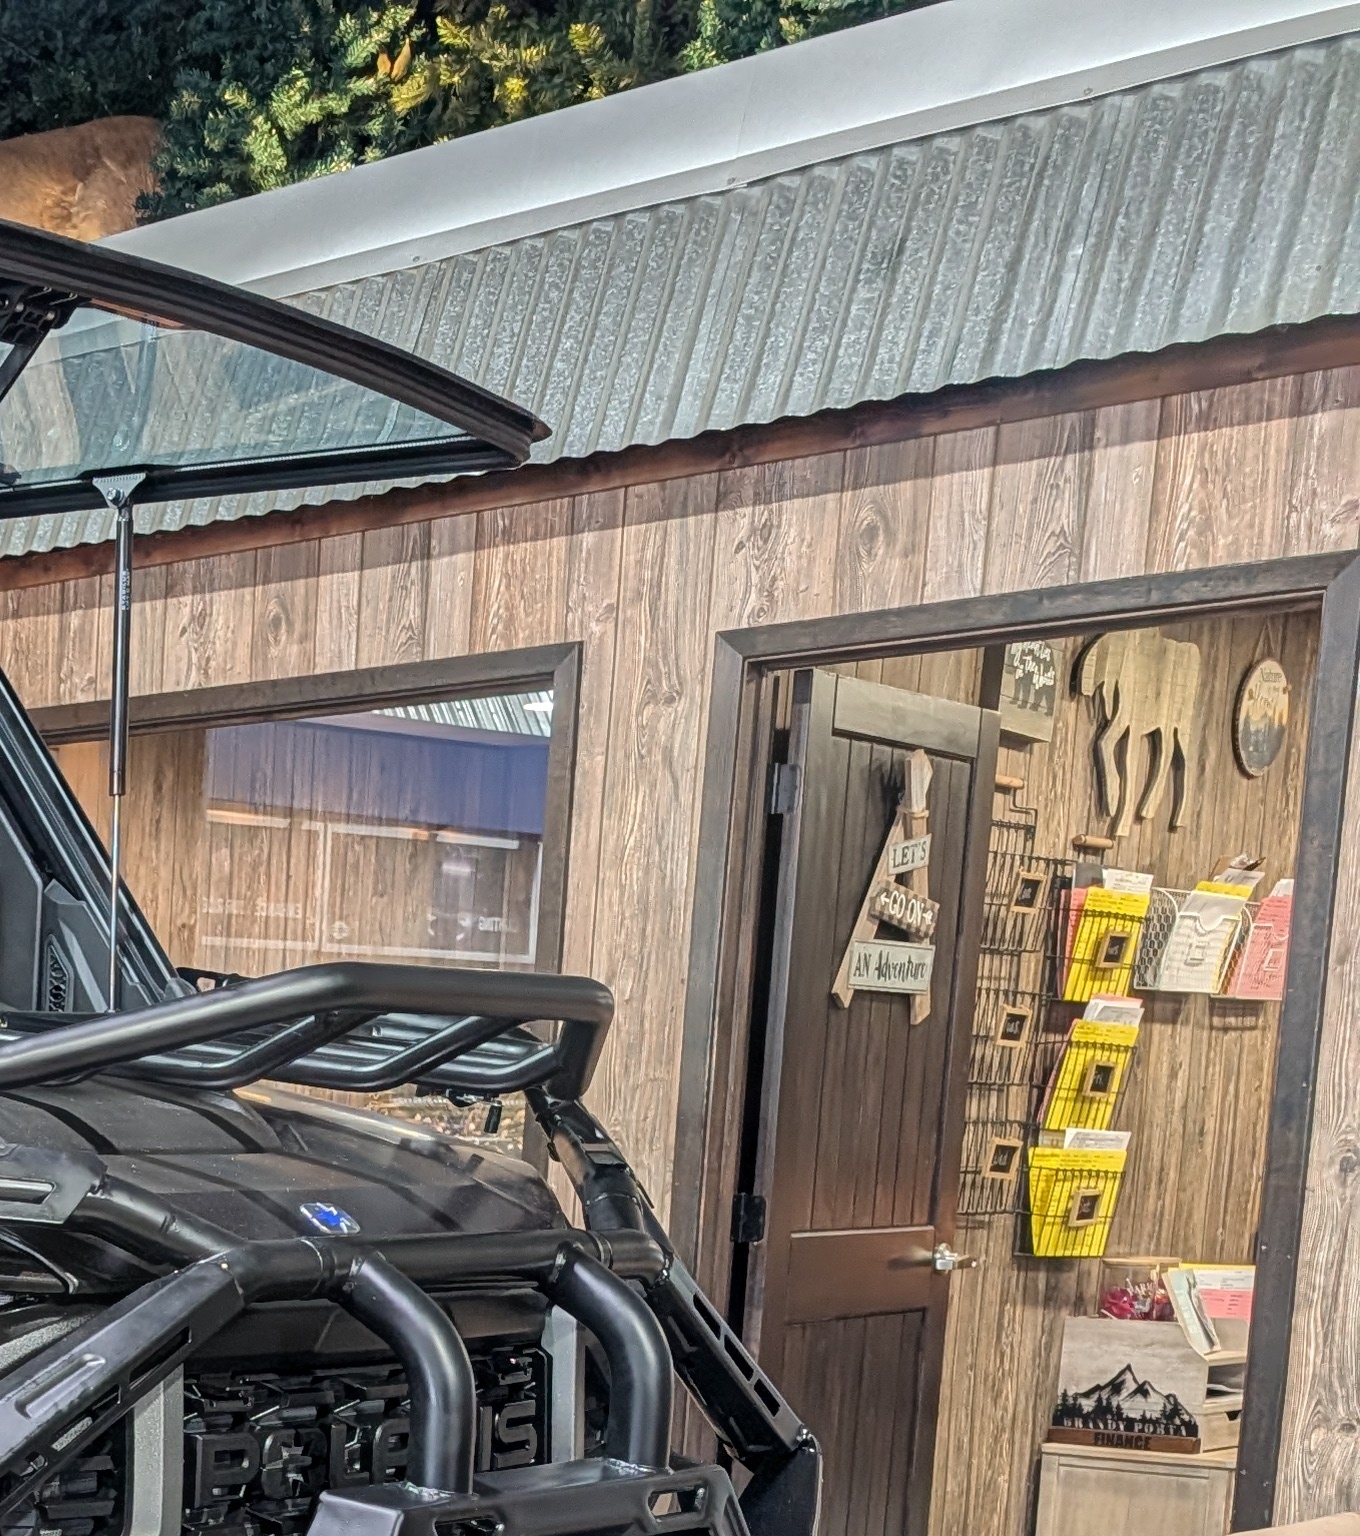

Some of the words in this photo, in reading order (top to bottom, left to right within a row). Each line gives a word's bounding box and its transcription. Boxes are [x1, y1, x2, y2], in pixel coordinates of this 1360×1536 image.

[892, 840, 927, 869] LET'S
[889, 890, 906, 918] GO
[907, 898, 925, 926] ON
[853, 951, 872, 978] AN
[195, 1400, 538, 1508] POLAIS
[1093, 1431, 1152, 1450] FINANCE
